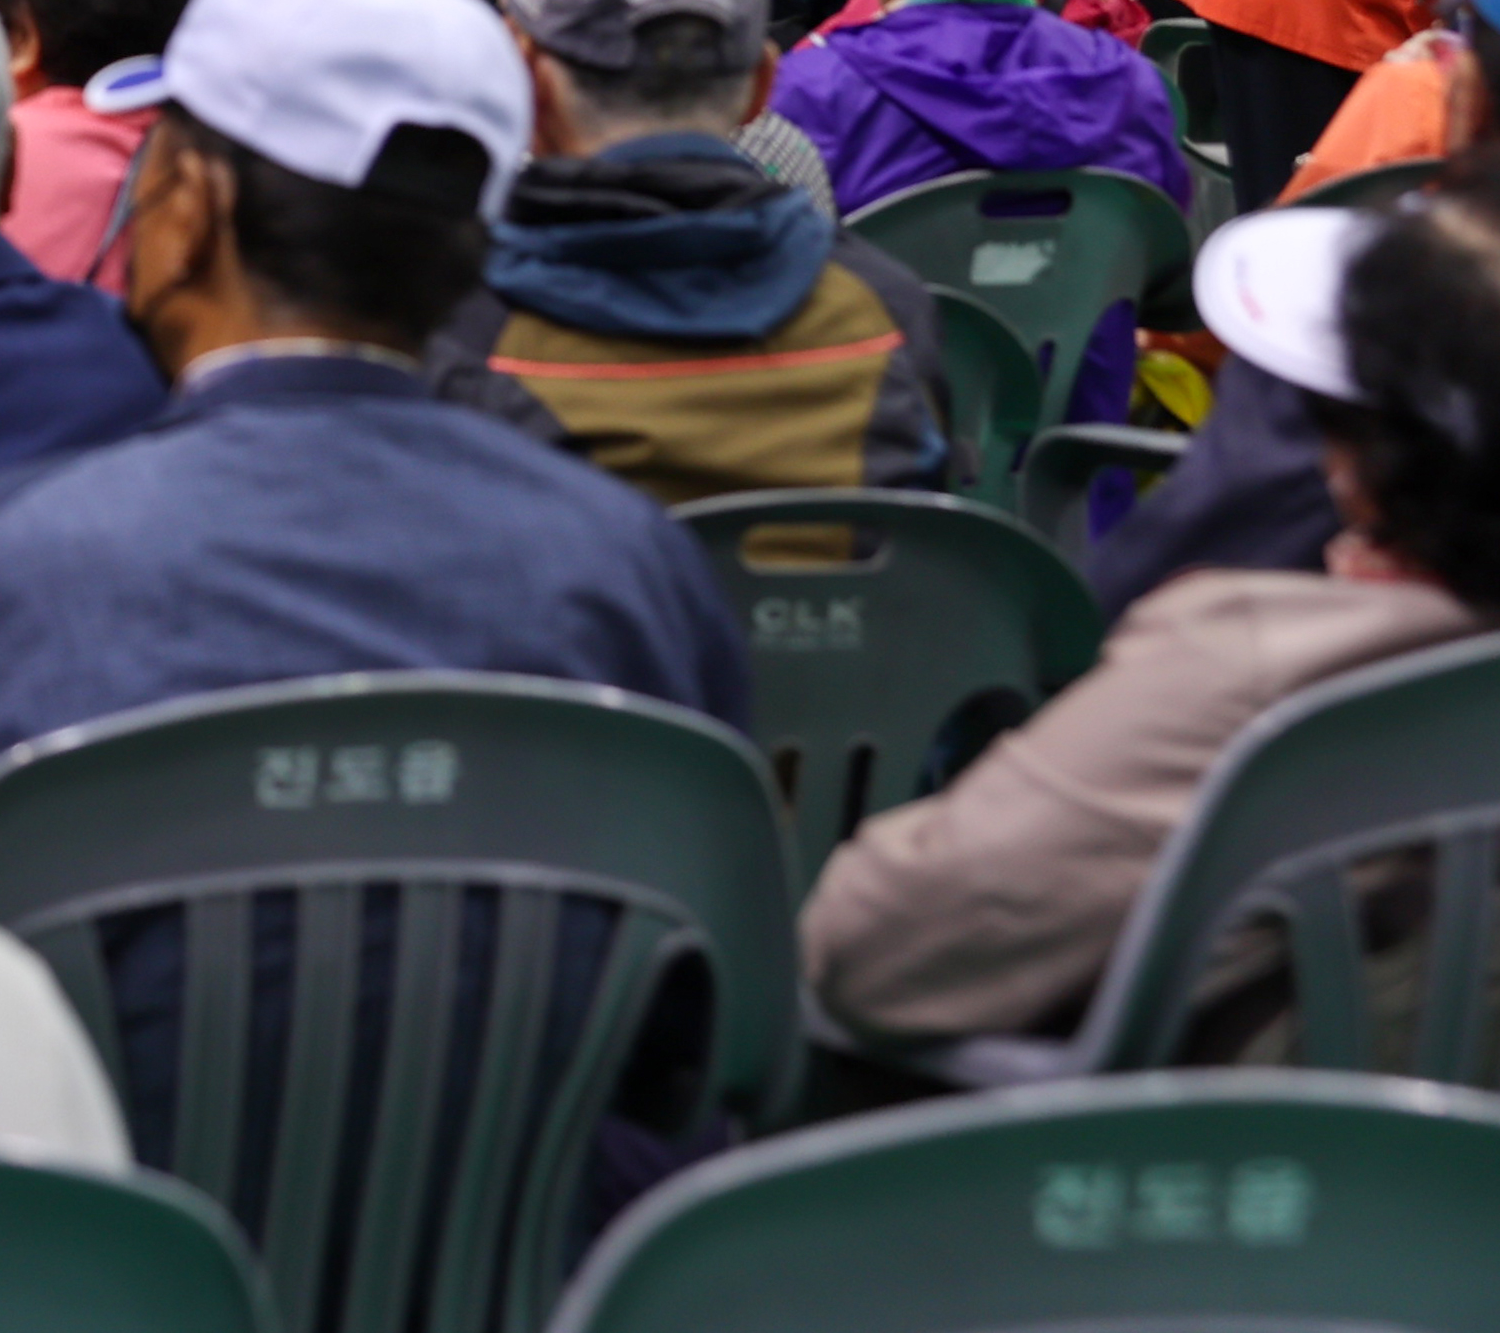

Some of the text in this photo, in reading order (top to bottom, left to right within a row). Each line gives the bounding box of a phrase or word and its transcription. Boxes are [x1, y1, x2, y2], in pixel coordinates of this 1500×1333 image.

[750, 596, 865, 633] CLK
[253, 742, 458, 806] 진도읍
[1032, 1159, 1313, 1248] 진도읍
